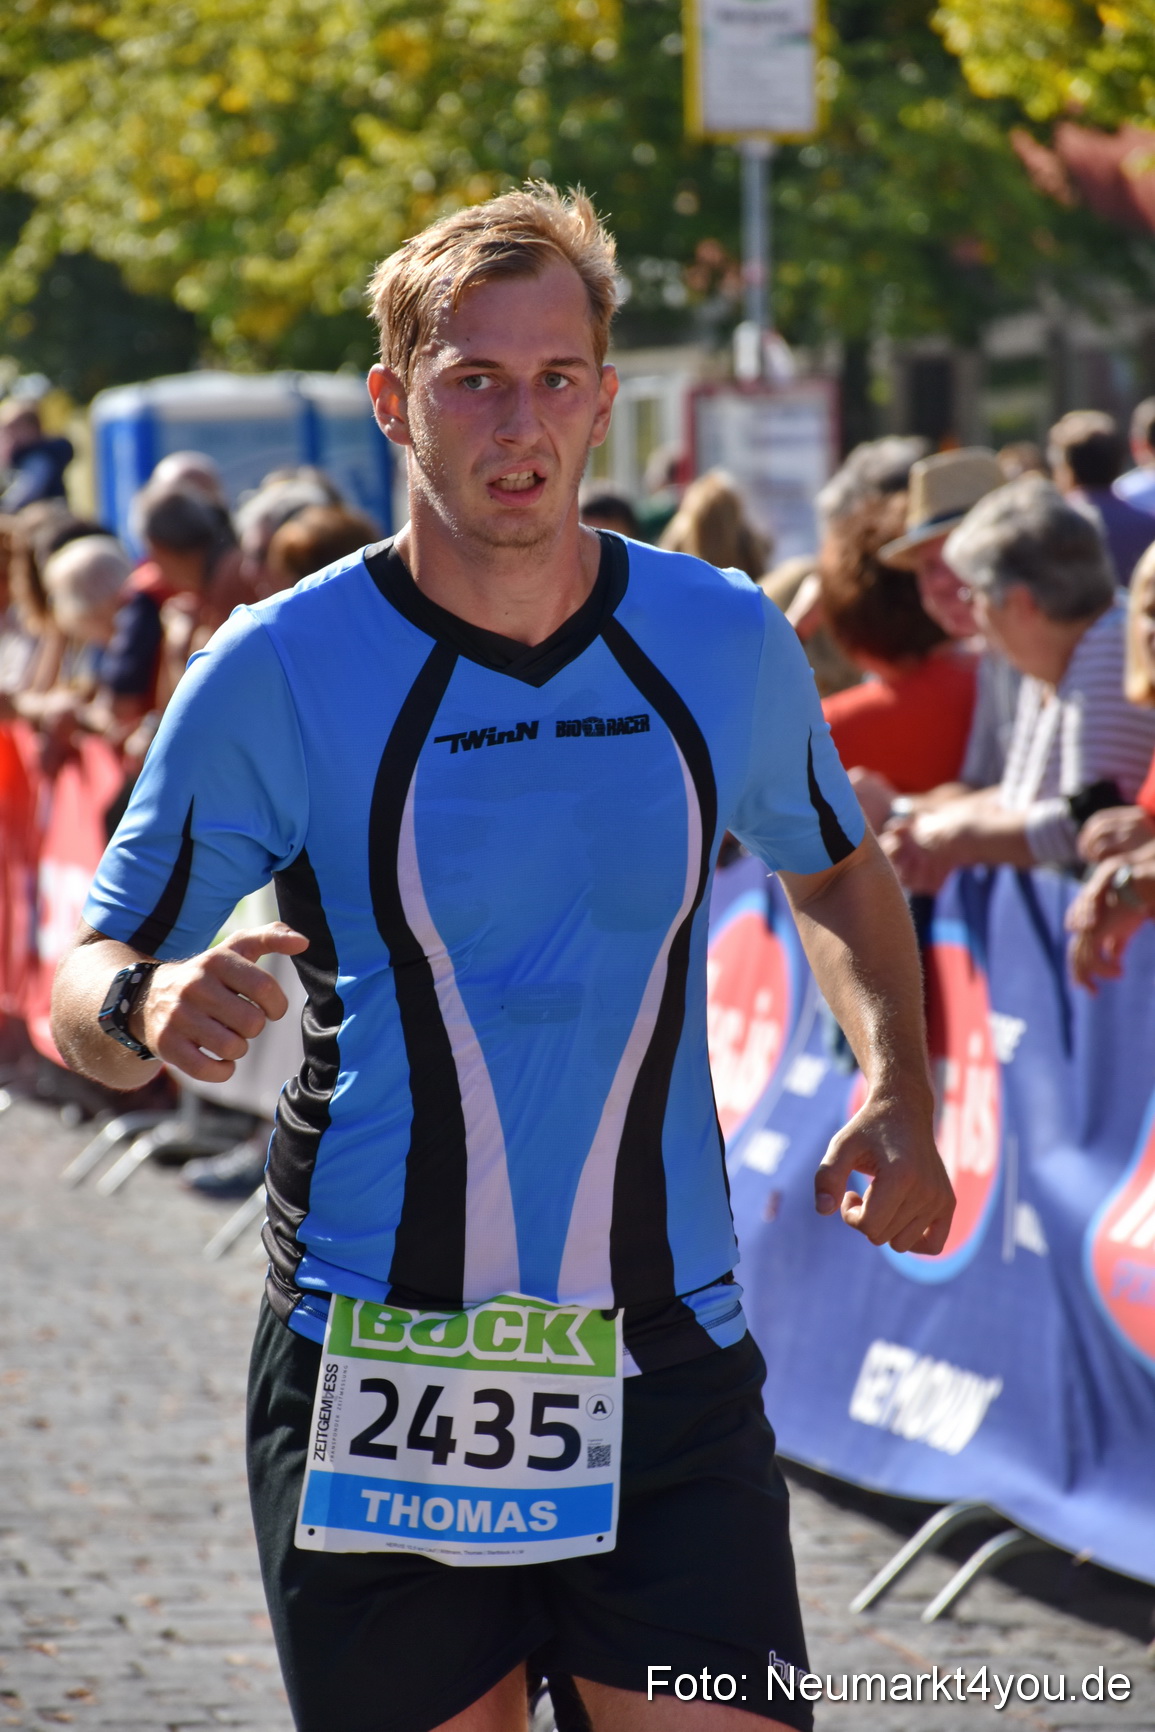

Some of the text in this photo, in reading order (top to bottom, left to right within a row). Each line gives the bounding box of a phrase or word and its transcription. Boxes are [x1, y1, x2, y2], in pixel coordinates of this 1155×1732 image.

[349, 1377, 582, 1472] 2435
[592, 1400, 608, 1415] A
[360, 1489, 559, 1533] THOMAS
